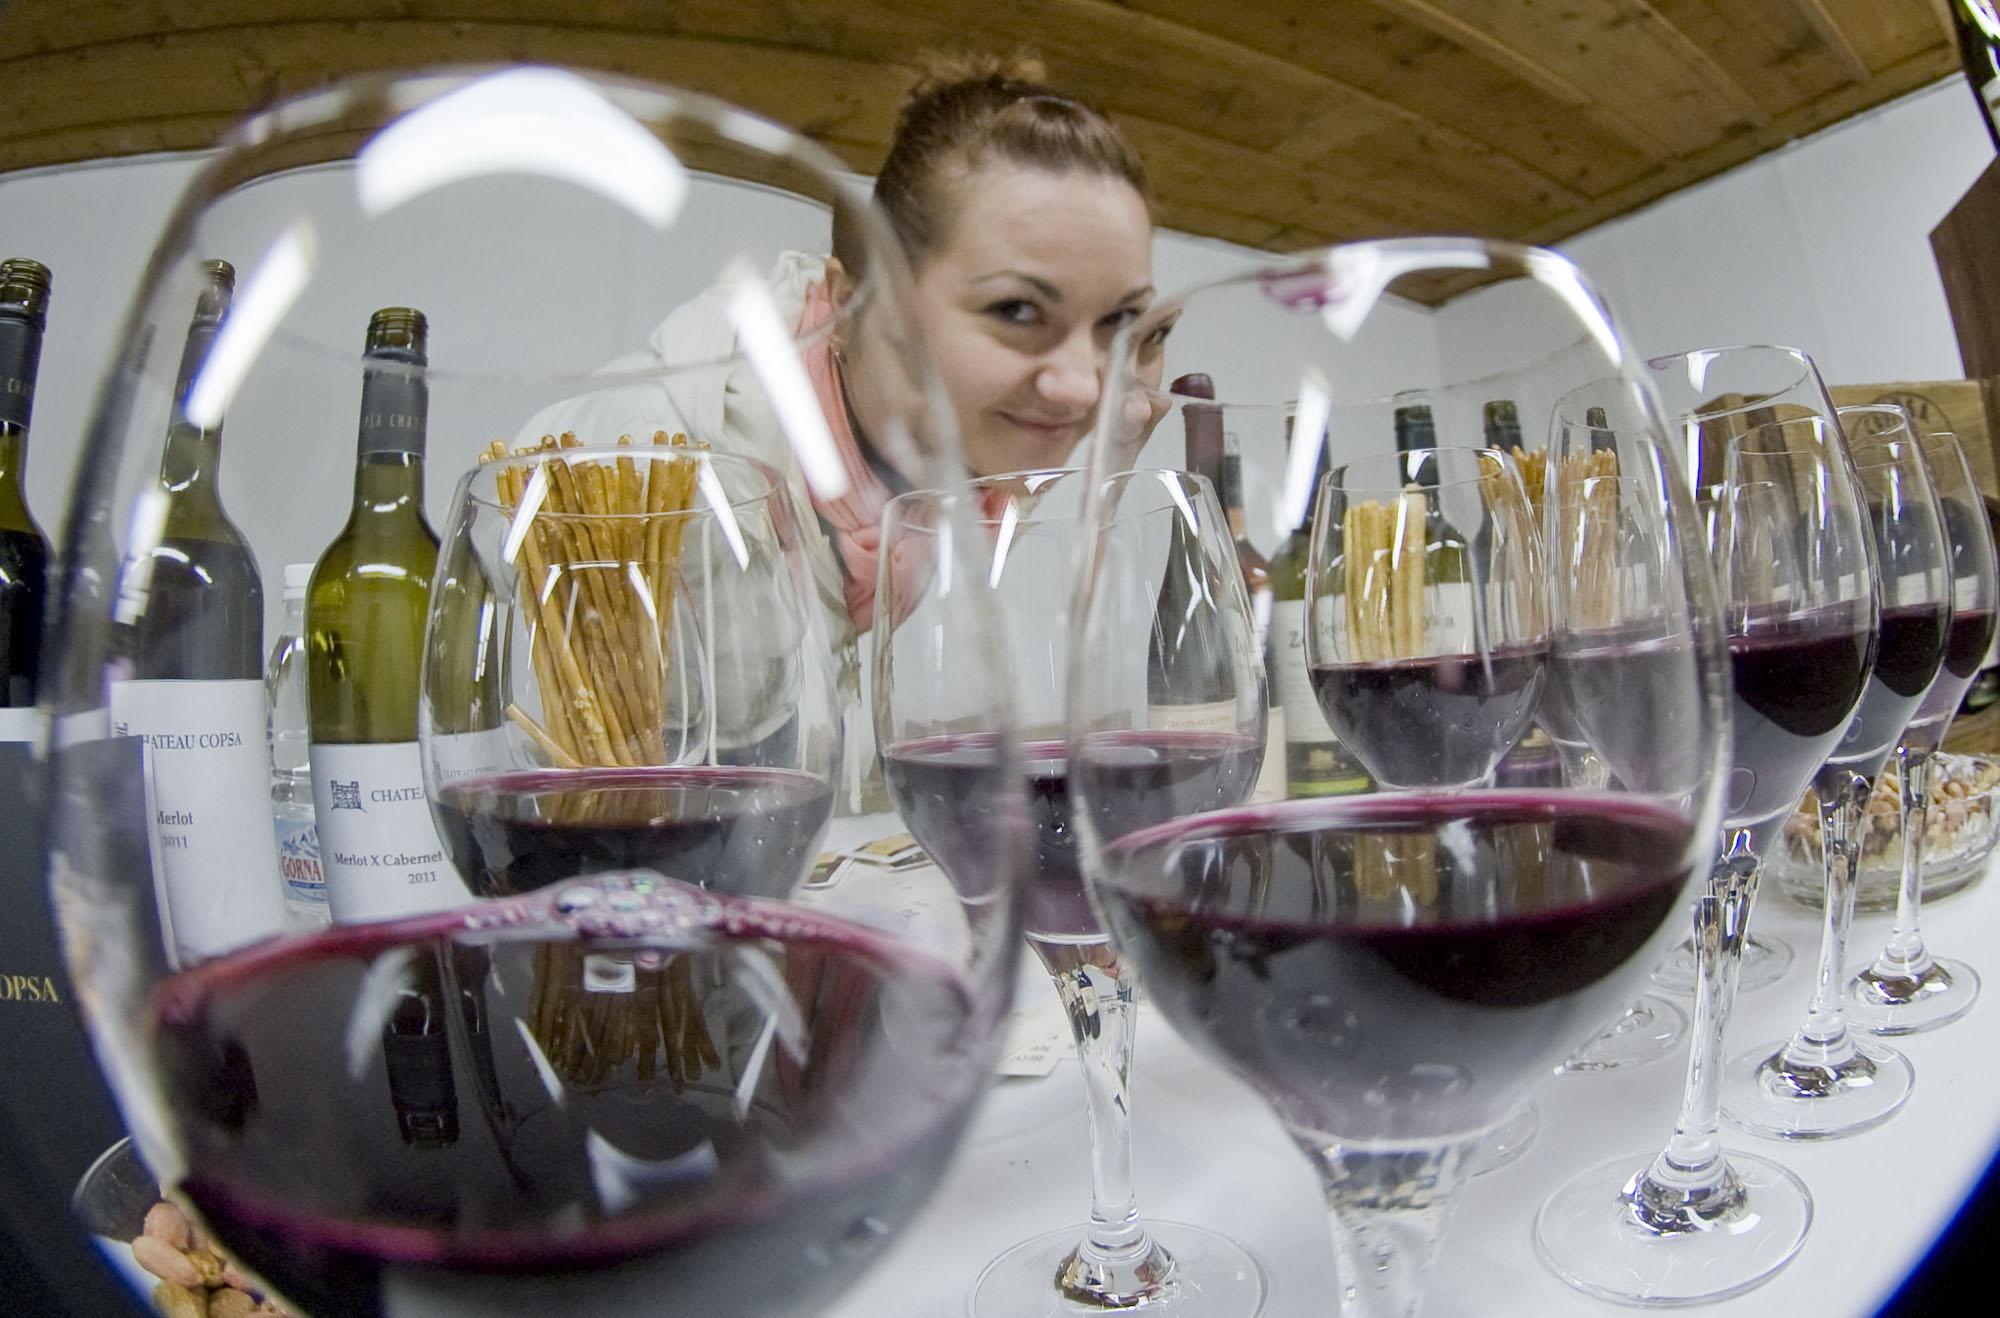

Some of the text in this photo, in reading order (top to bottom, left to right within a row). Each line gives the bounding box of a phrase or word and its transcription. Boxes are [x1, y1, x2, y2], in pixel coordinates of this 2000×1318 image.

[143, 733, 242, 749] HATEAU COPSA
[371, 787, 425, 802] CHATE
[335, 851, 443, 867] Merlot X Cabernet
[282, 855, 322, 882] GORNA
[408, 871, 437, 884] 2011
